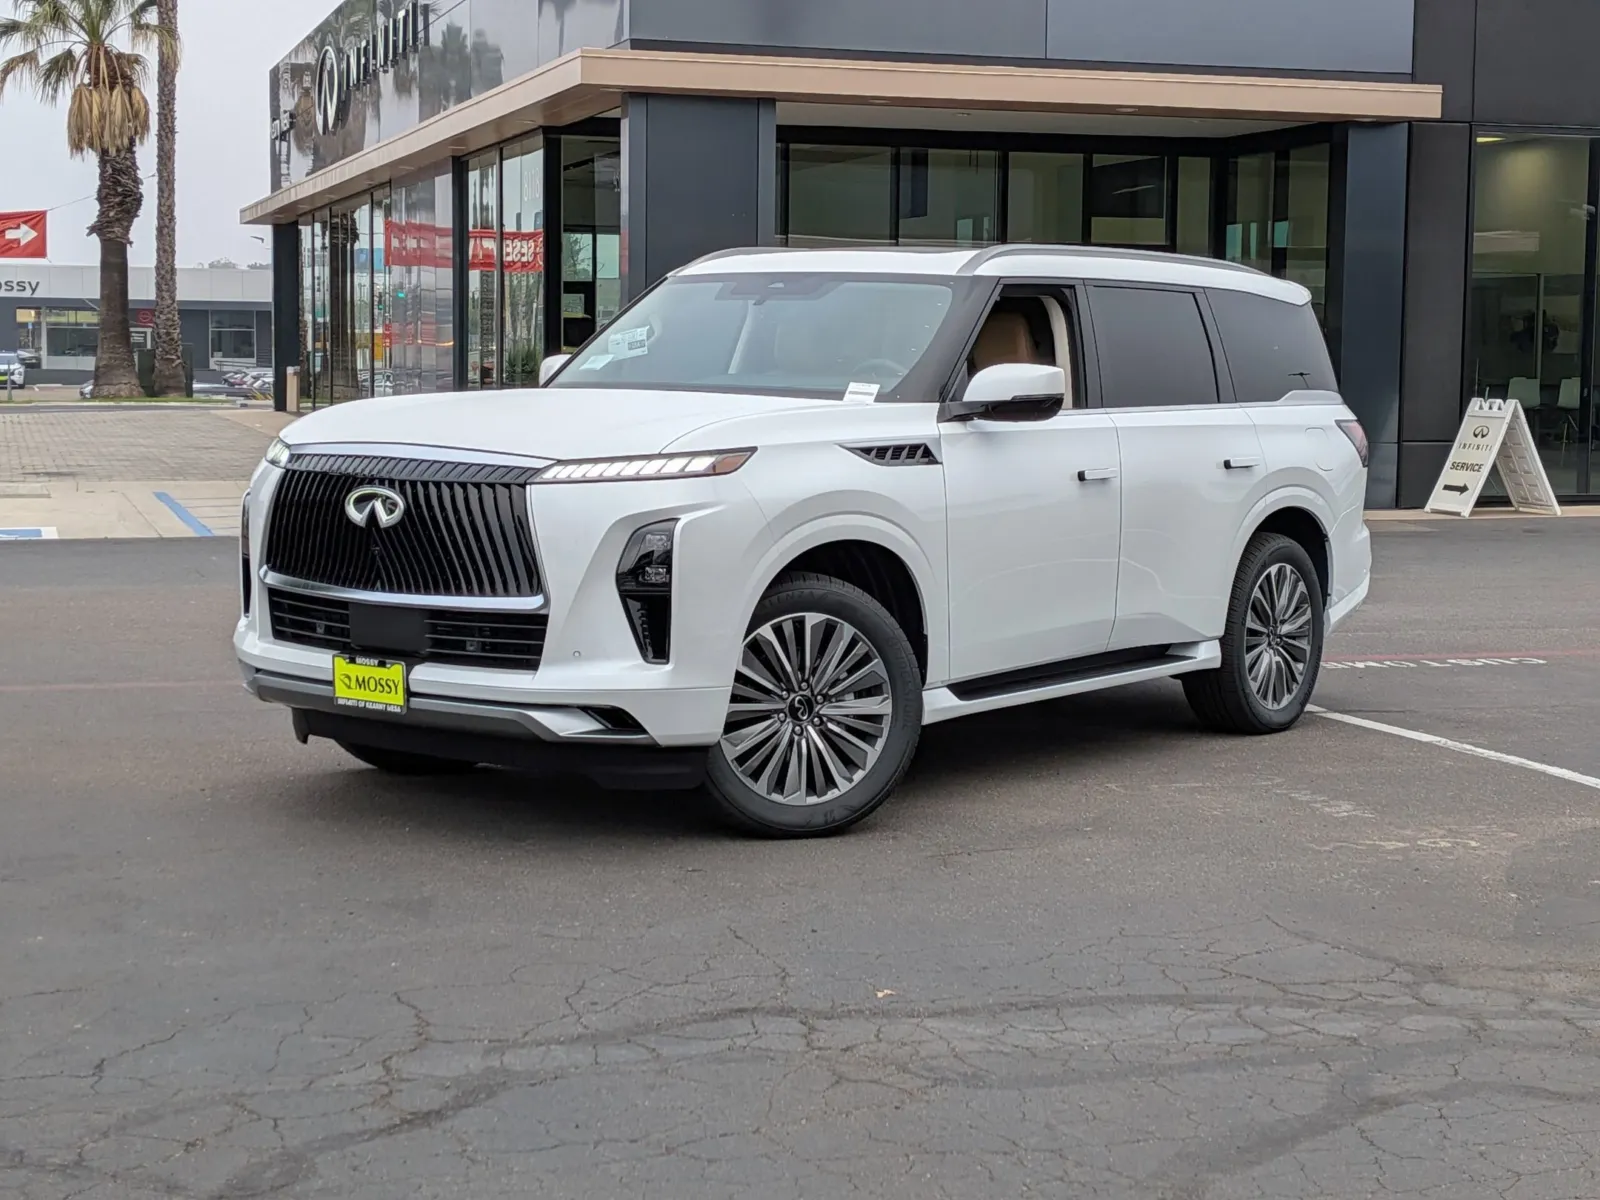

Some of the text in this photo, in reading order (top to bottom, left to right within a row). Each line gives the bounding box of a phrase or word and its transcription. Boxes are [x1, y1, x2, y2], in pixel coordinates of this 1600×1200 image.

[343, 2, 416, 92] INFINITI
[0, 280, 40, 296] ssy
[1458, 442, 1493, 452] INFINITI
[1450, 461, 1484, 473] SERVICE
[355, 655, 379, 667] MOSSY
[356, 675, 400, 695] MOSSY
